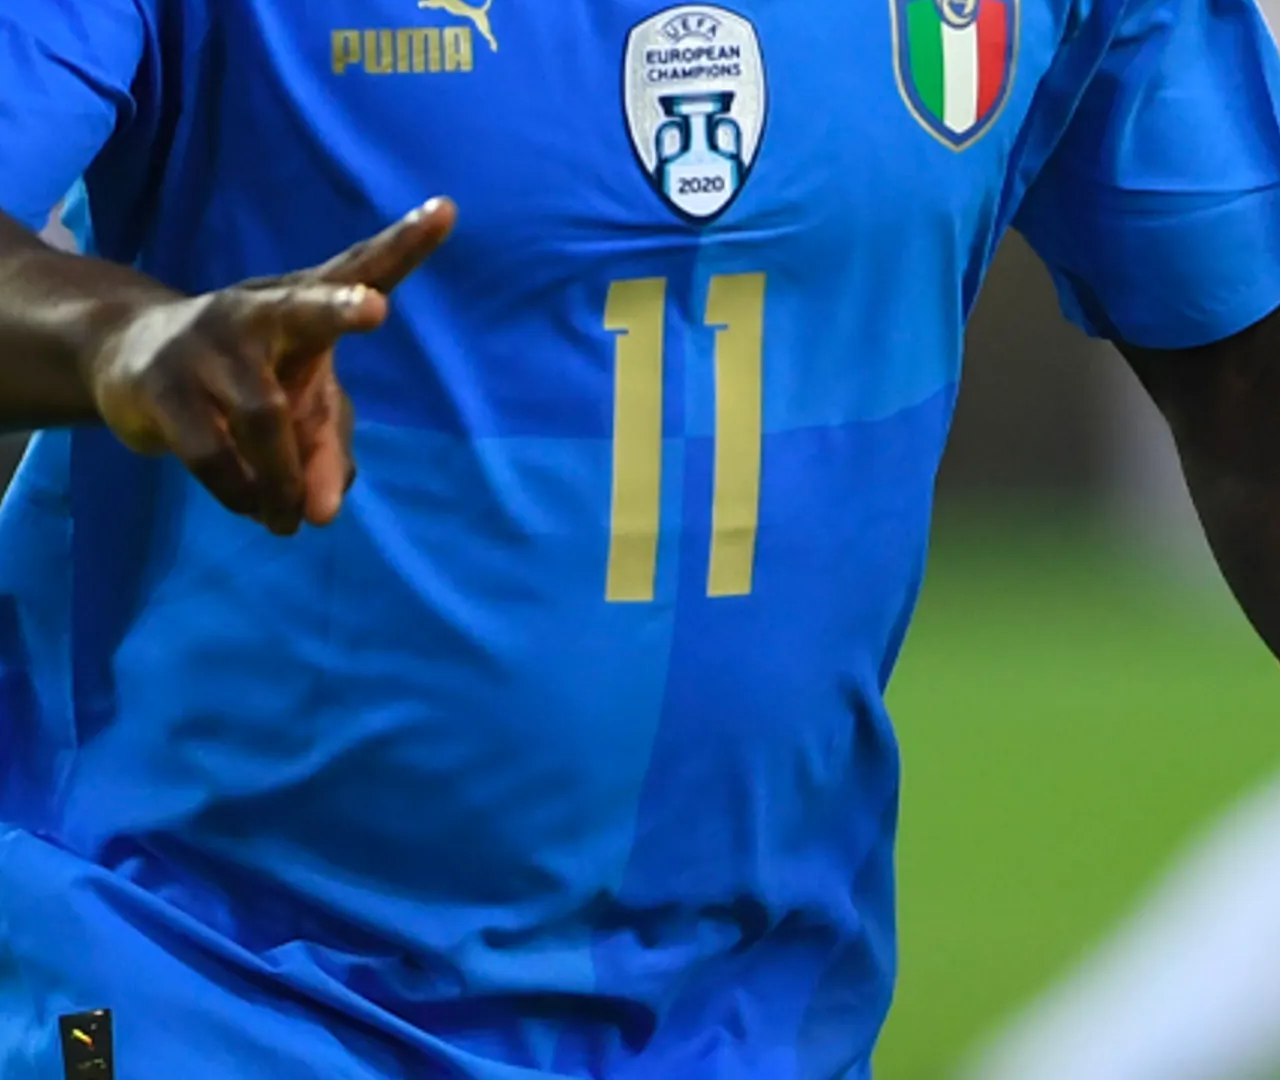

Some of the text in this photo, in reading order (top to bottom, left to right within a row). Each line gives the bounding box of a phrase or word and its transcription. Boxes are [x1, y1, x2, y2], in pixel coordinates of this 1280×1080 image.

[666, 16, 717, 39] UEFA
[332, 26, 473, 74] PUMA
[646, 46, 741, 65] EUROPEAN
[647, 64, 741, 82] CHAMPIONS
[678, 176, 725, 194] 2020
[604, 272, 766, 602] 11
